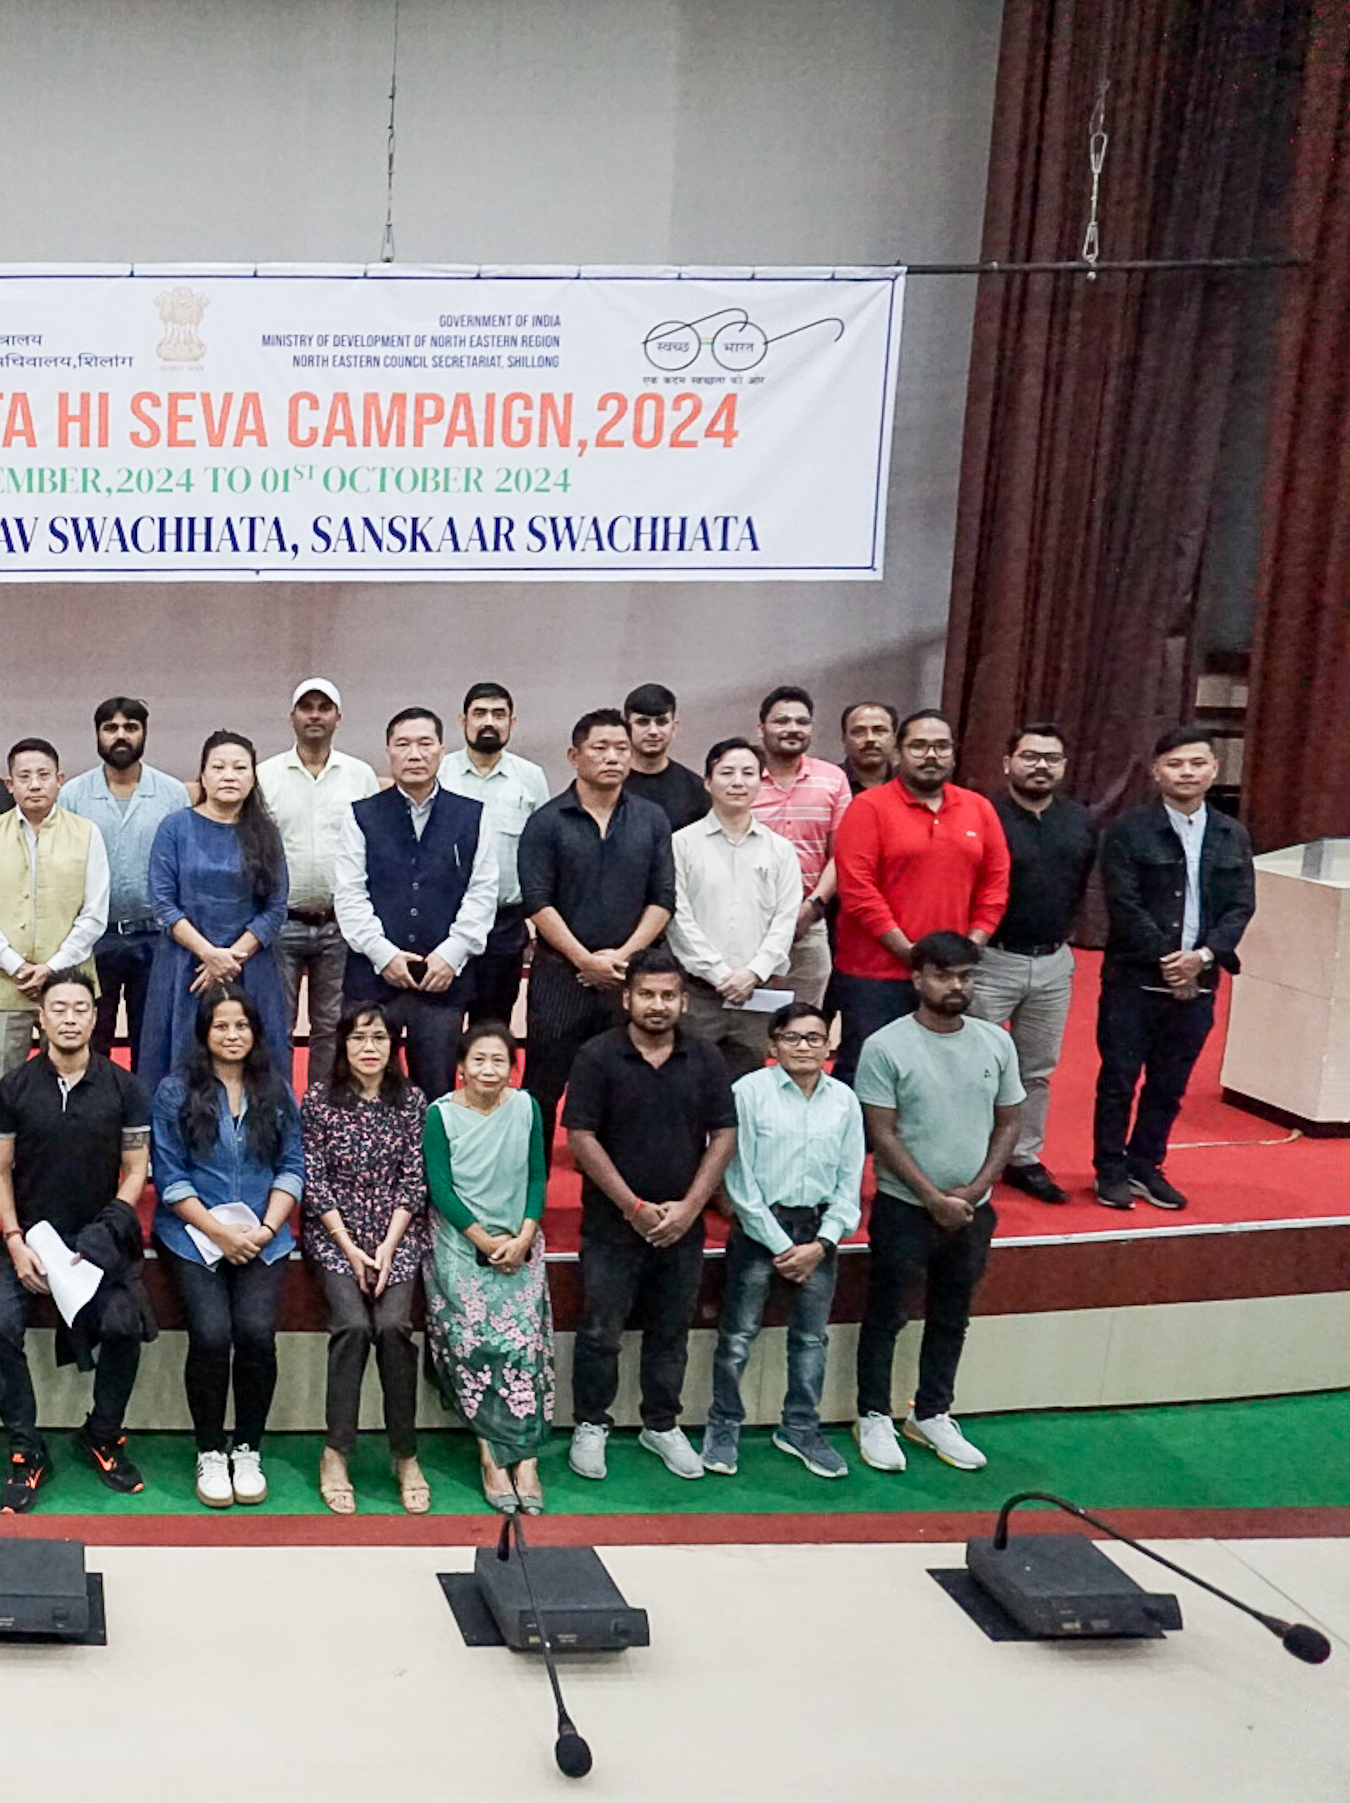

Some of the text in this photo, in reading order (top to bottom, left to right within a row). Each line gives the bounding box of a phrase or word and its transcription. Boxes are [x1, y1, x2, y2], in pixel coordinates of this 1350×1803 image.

[439, 314, 561, 327] GOVERNMENT OF INDIA
[261, 334, 560, 347] MINISTRY OF DEVELOPMENT OF NORTH EASTERN REGION
[656, 341, 754, 353] स्वच्छ भारत
[292, 354, 560, 369] NORTH EASTERN COUNCIL SECRETARIAT, SHILLONG
[58, 392, 109, 448] HI
[130, 392, 268, 448] SEVA
[288, 392, 738, 457] CAMPAIGN,2024
[205, 467, 251, 493] TO
[261, 464, 317, 493] 01ST
[322, 466, 484, 493] OCTOBER
[495, 467, 571, 493] 2024
[49, 517, 298, 559] SWACHHATA,
[311, 516, 516, 553] SANSKAAR
[527, 516, 761, 553] SWACHHATA
